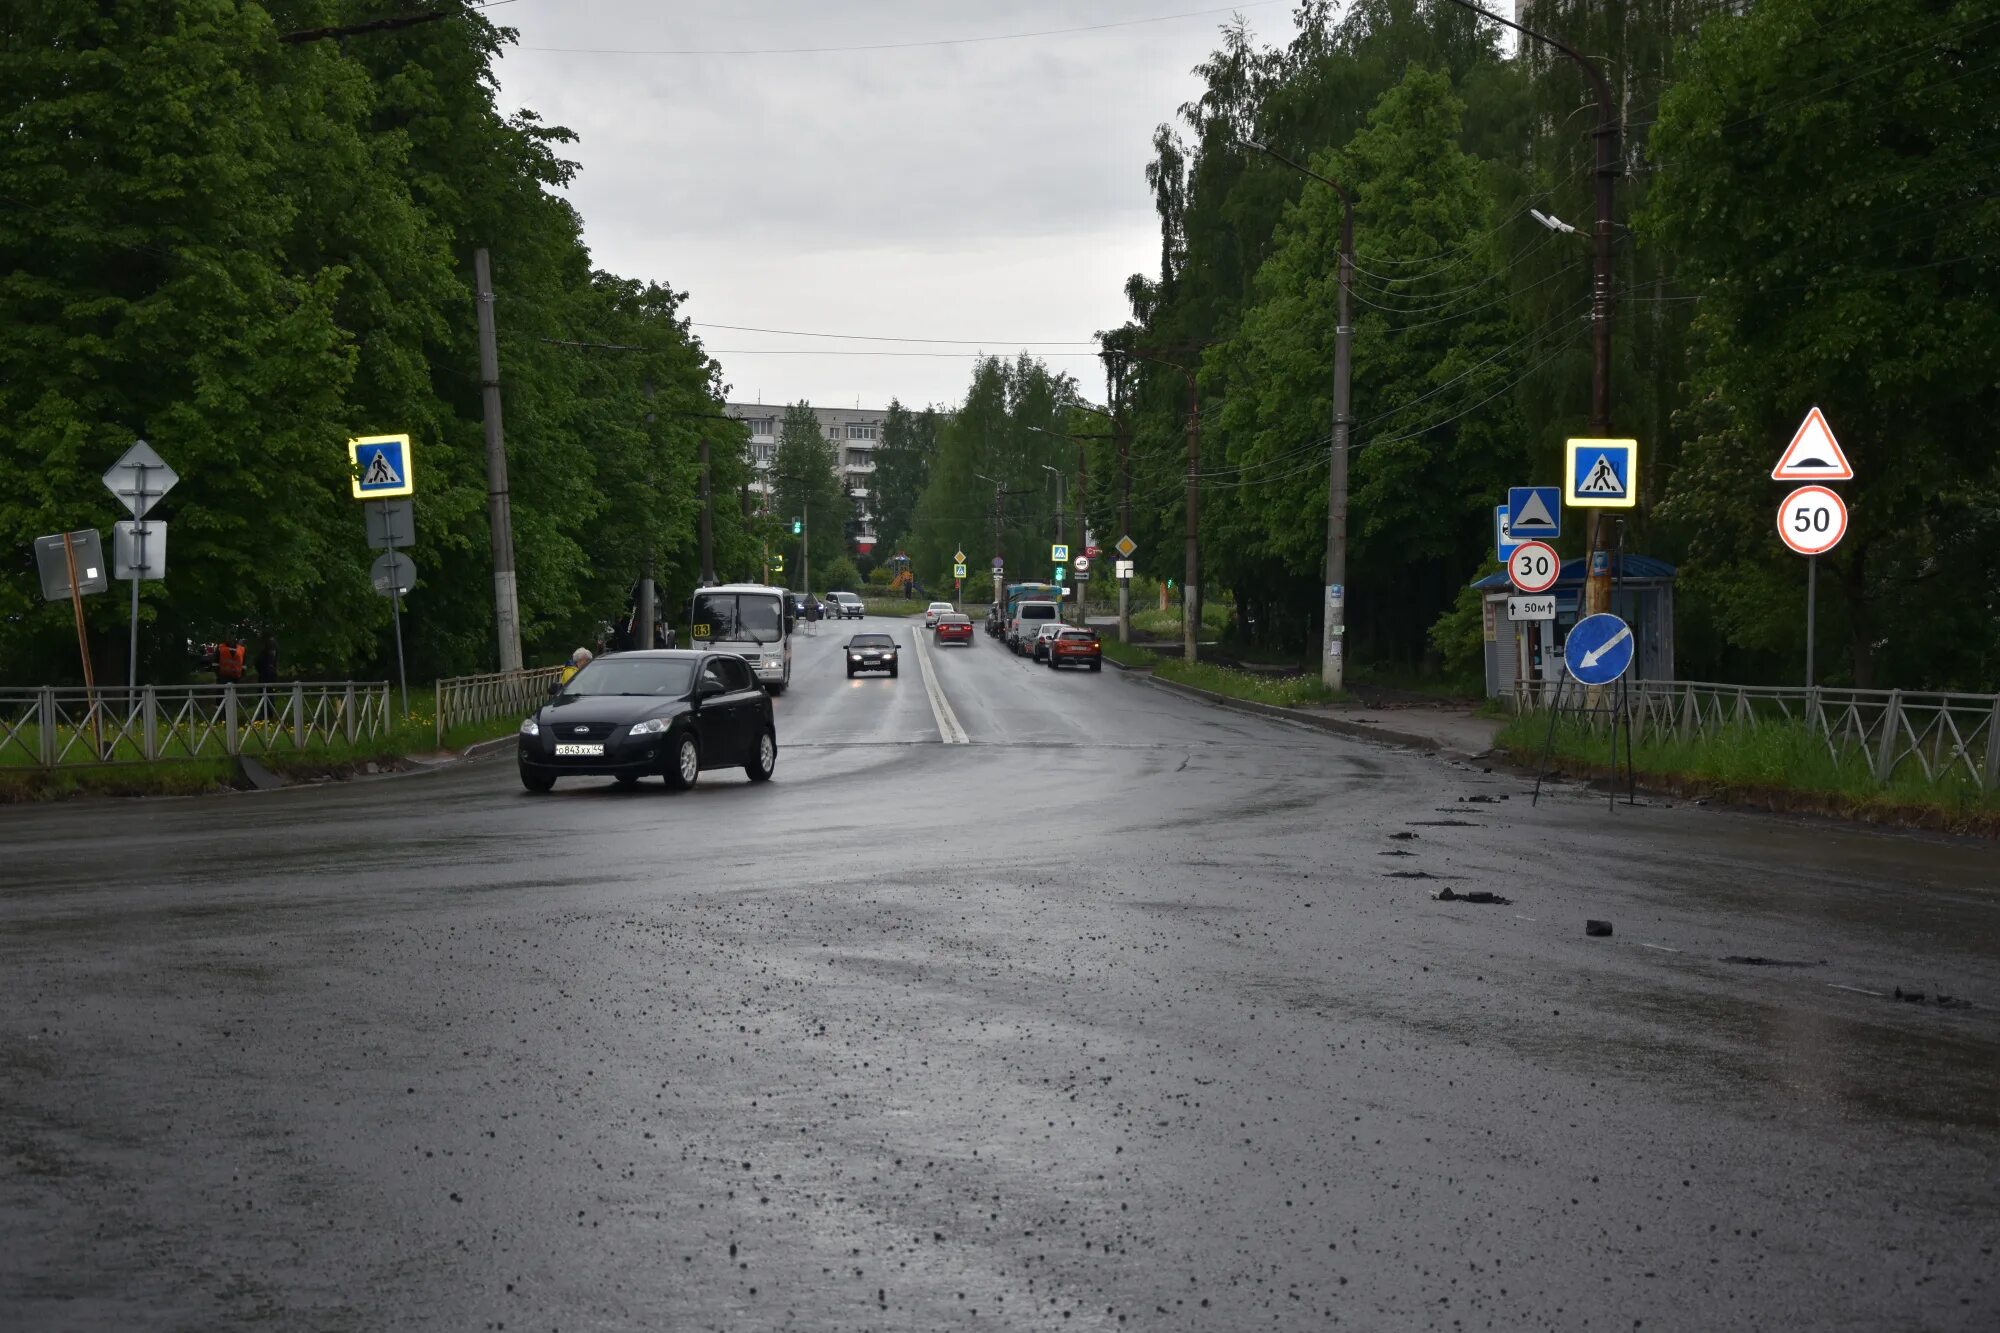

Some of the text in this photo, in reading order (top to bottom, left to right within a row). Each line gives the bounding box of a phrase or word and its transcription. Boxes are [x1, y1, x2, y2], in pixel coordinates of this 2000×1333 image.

[1794, 507, 1830, 533] 50
[1520, 556, 1549, 576] 30
[695, 625, 709, 636] 83
